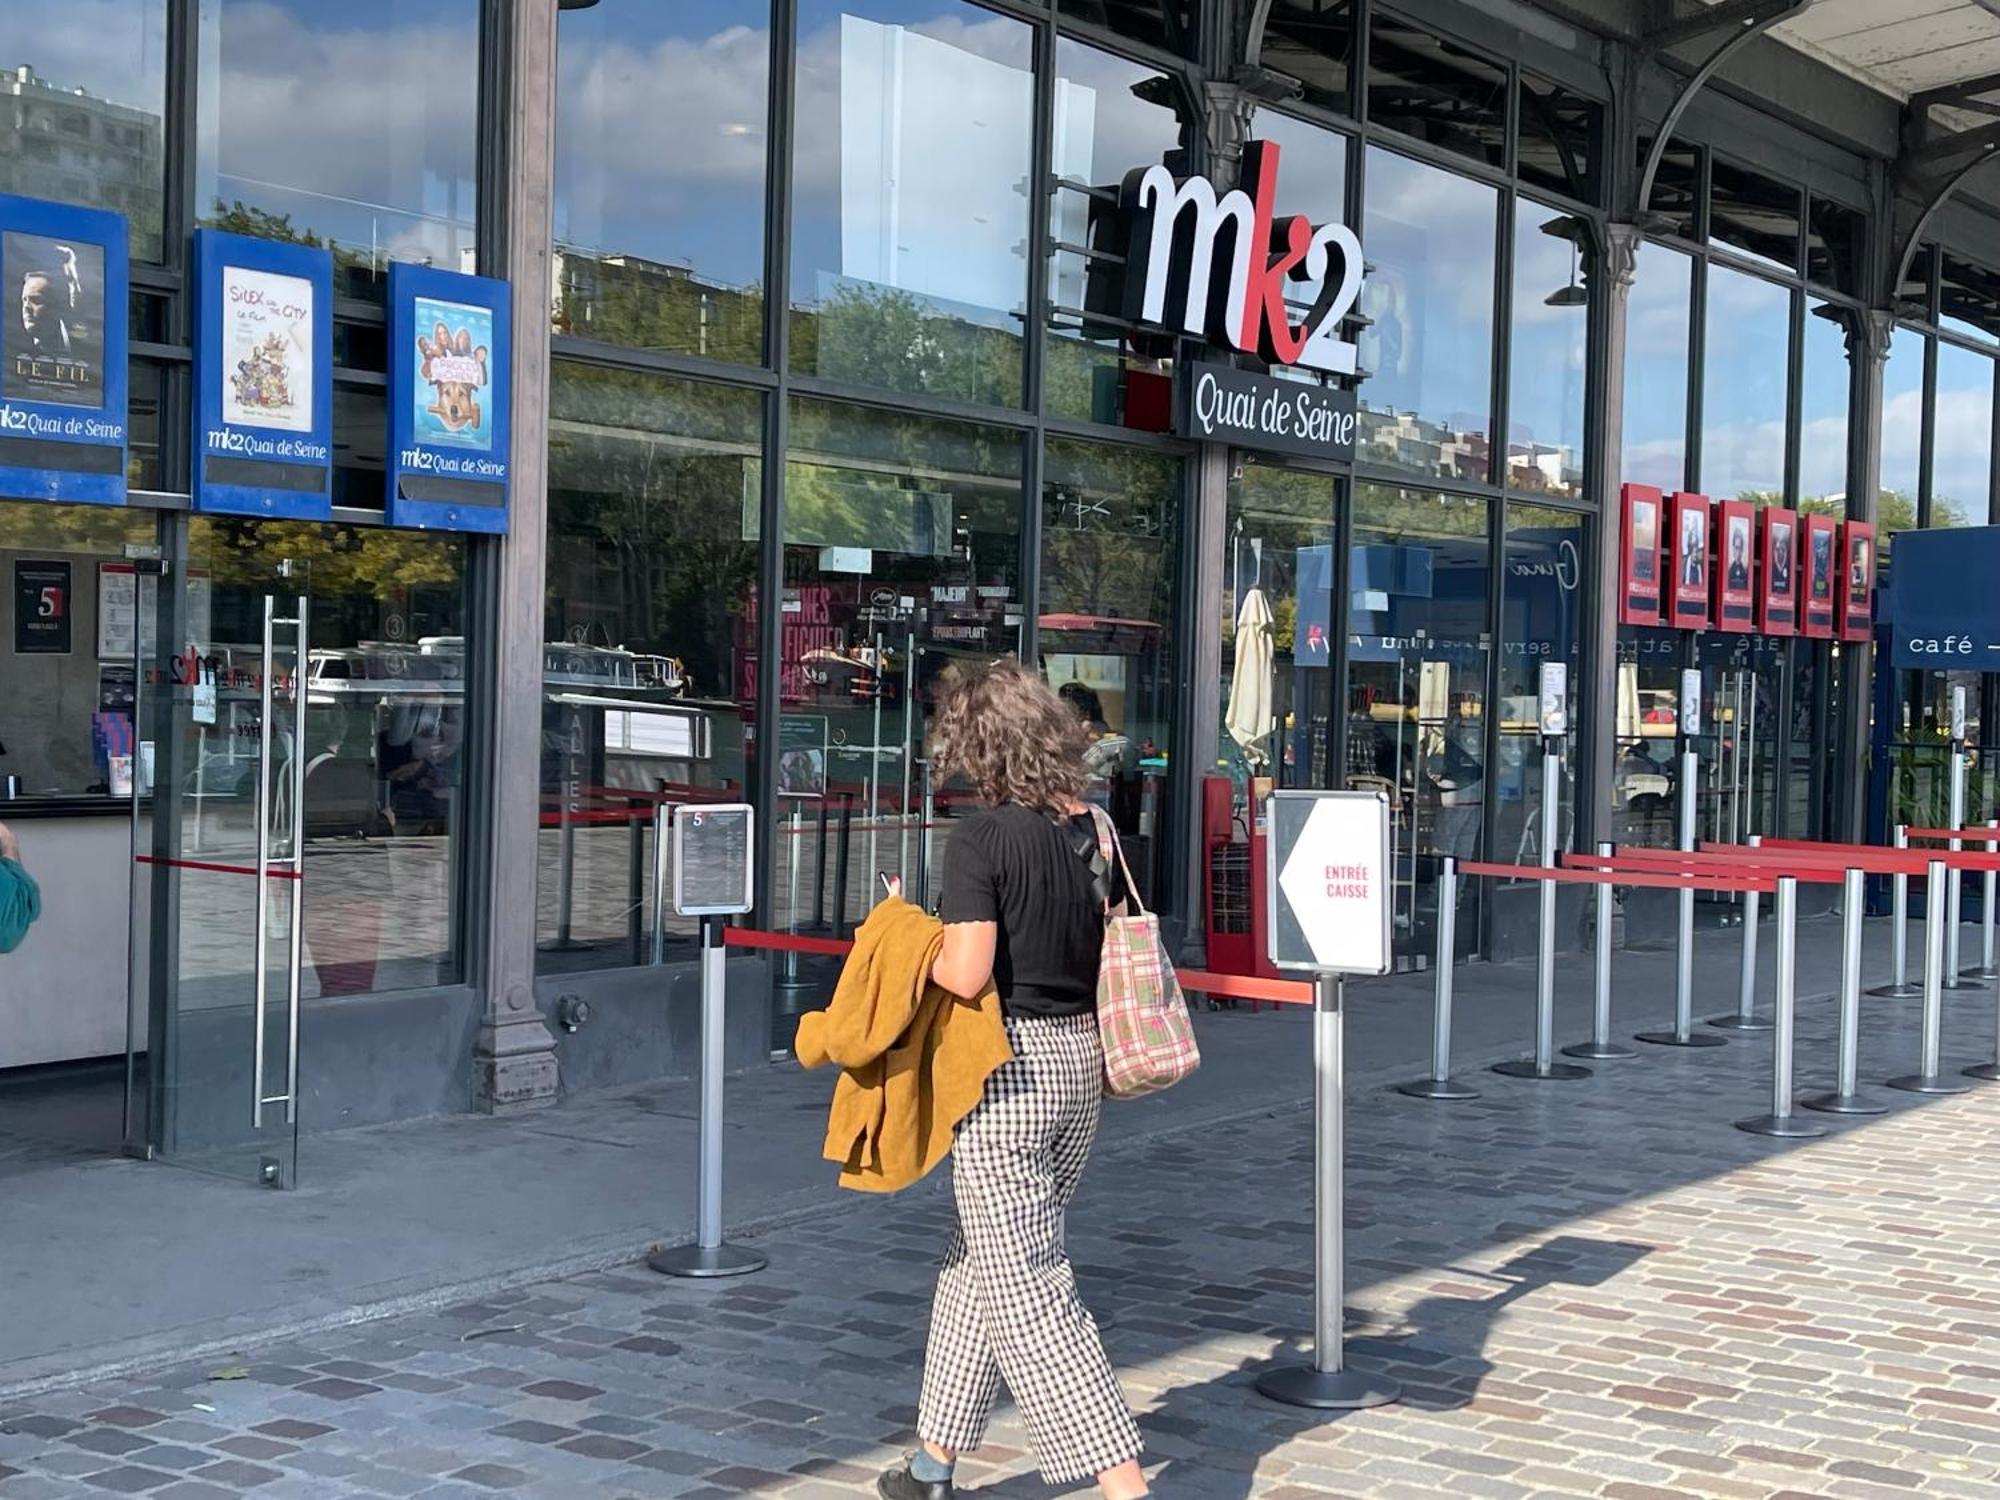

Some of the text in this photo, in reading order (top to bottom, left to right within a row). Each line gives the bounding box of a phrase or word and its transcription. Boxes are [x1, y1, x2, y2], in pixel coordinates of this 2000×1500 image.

[1139, 139, 1364, 375] mk2
[16, 360, 41, 377] LE
[56, 365, 89, 382] FIL
[1195, 372, 1354, 446] Quai de Seine
[28, 413, 62, 434] Quai
[65, 417, 82, 434] de
[85, 419, 122, 439] Seine
[208, 427, 327, 459] mk2 Quai de Seine
[401, 448, 505, 476] mk2 Quai de Seine
[38, 587, 56, 617] 5
[1909, 635, 1973, 654] café
[693, 812, 703, 827] 5
[1325, 863, 1369, 881] ENTRÉE
[1327, 883, 1369, 899] CAISSE
